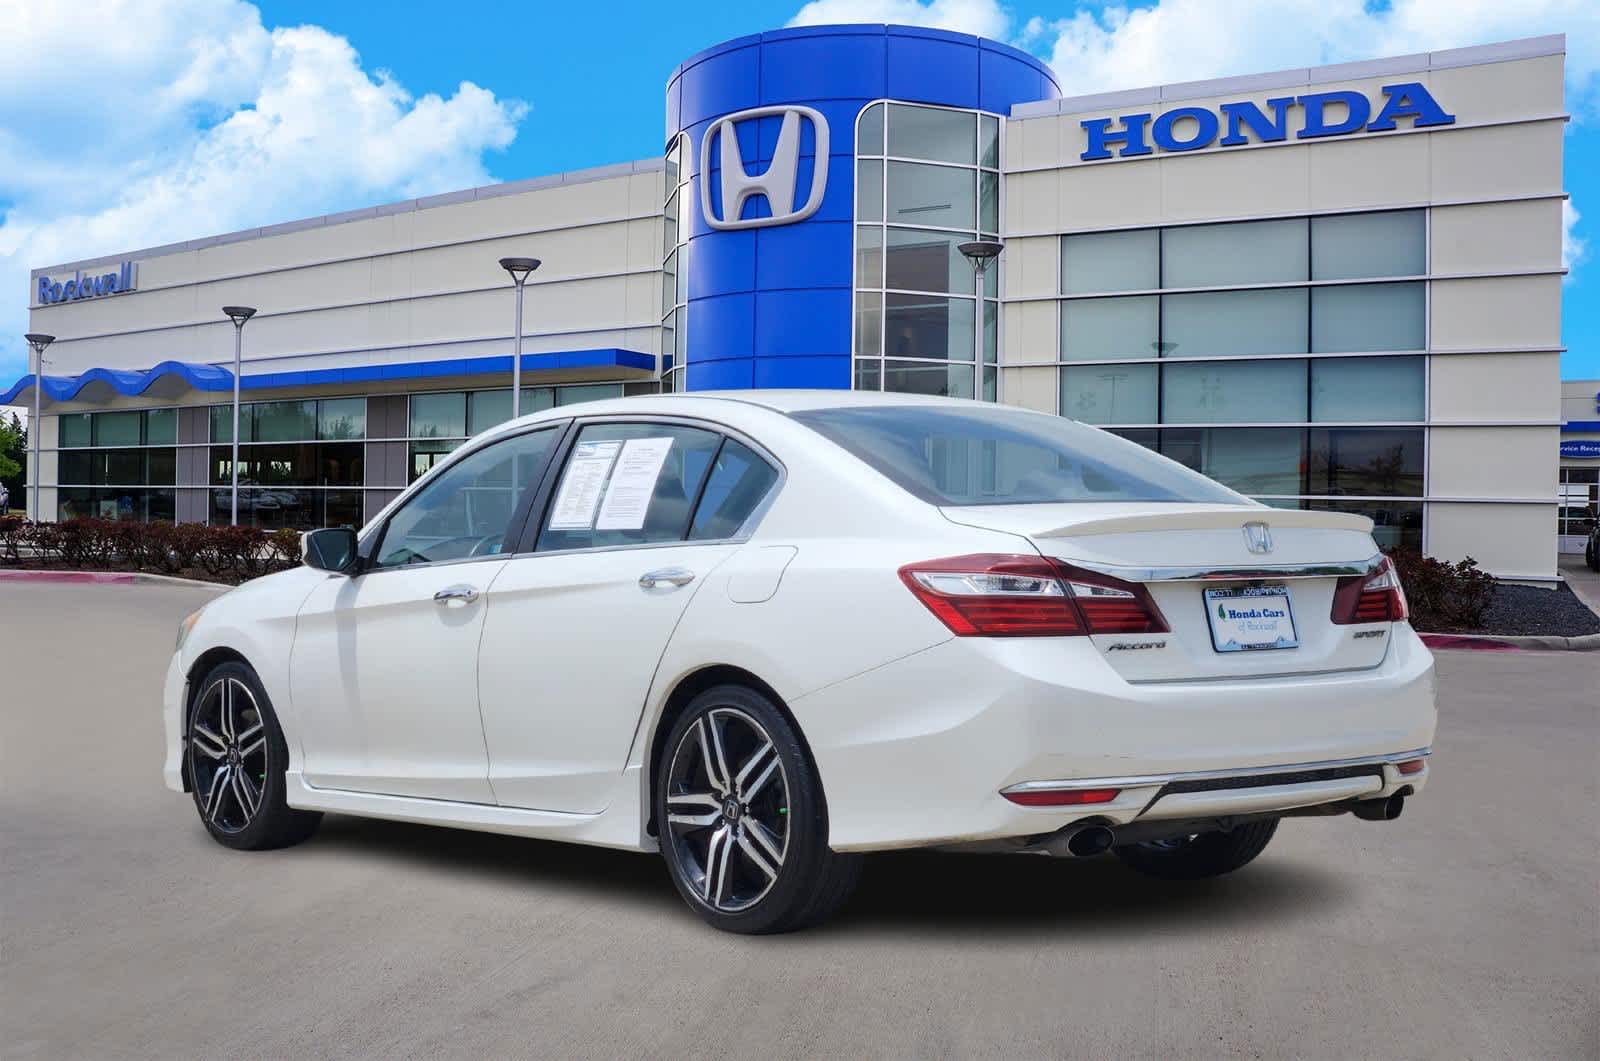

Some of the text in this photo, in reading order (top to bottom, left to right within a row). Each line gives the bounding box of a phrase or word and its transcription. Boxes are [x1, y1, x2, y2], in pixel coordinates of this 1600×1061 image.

[1080, 82, 1456, 161] HONDA
[38, 261, 132, 305] Rockwall
[1228, 608, 1285, 619] Honda Cars
[1107, 641, 1167, 651] Accord
